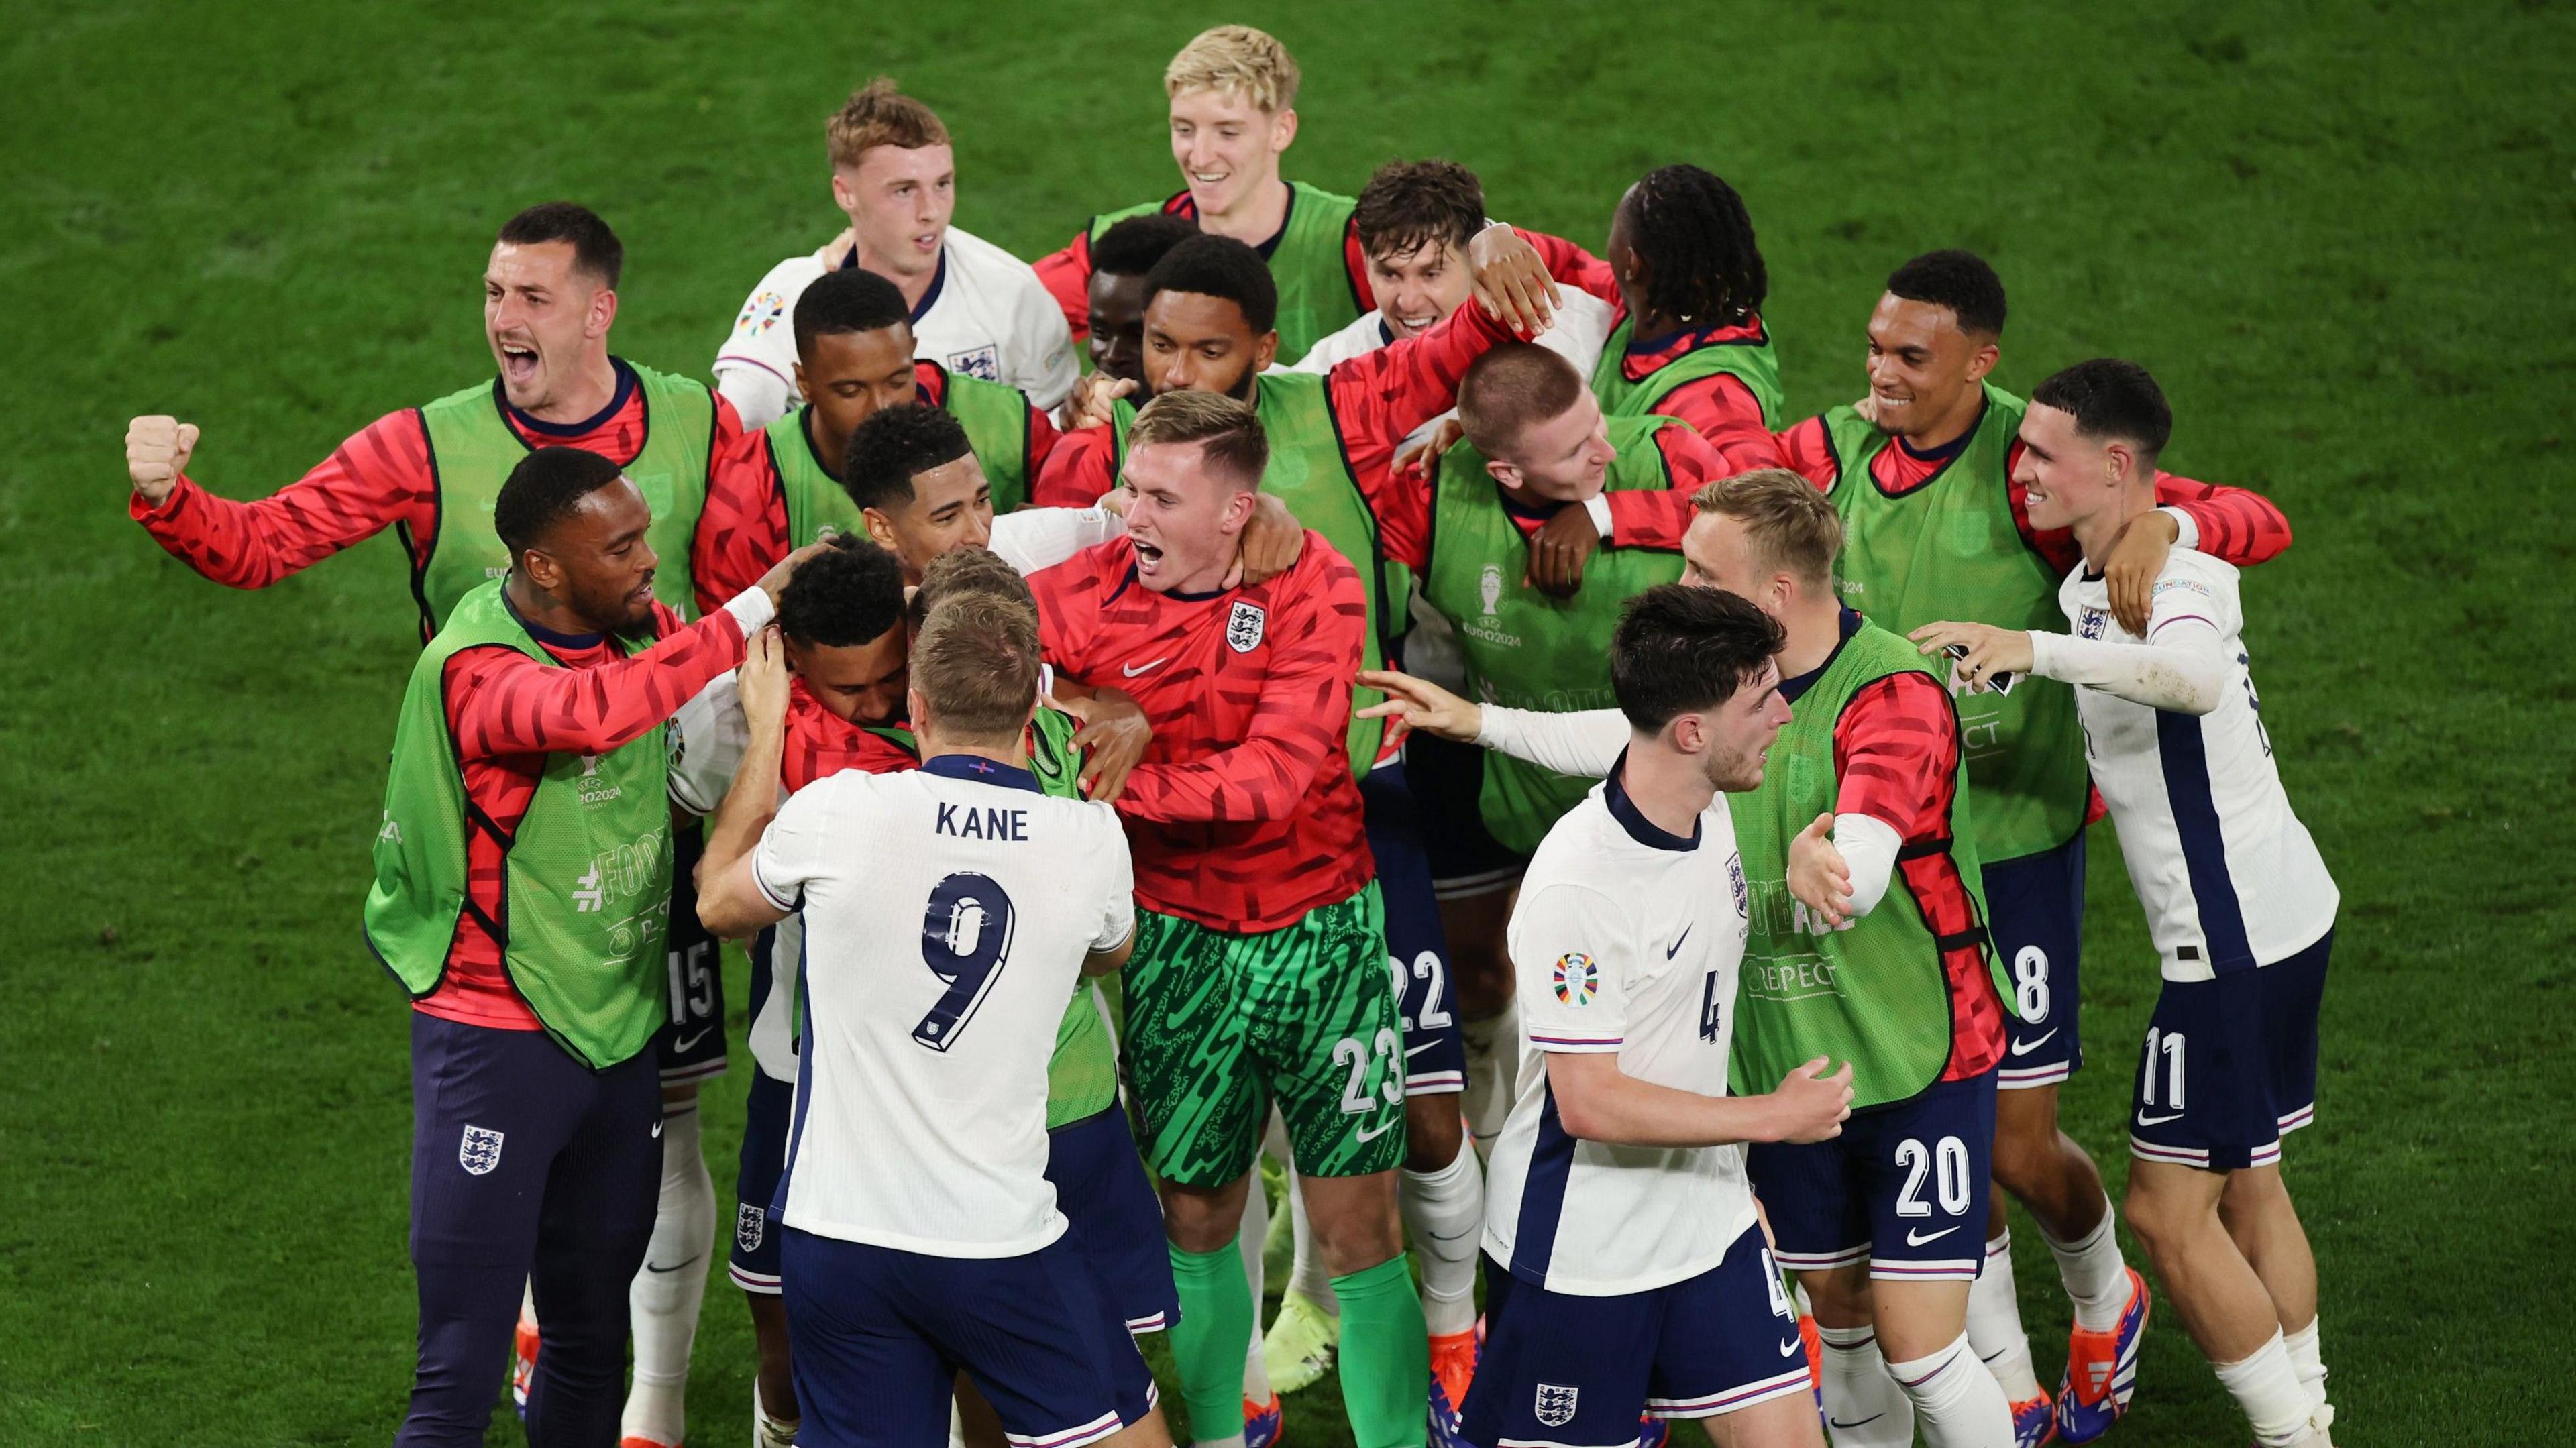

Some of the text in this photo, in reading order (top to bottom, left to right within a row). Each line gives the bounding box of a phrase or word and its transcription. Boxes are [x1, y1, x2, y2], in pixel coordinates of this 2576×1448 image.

[936, 801, 1028, 841] KANE
[668, 940, 714, 1025] 15
[911, 871, 1016, 1053] 9
[1389, 950, 1452, 1030] 22
[2015, 945, 2049, 1025] 8
[1700, 970, 1719, 1045] 4
[1332, 1028, 1406, 1115] 23
[2143, 1026, 2186, 1110] 11
[1895, 1135, 1971, 1217] 20
[1761, 1248, 1796, 1323] 4
